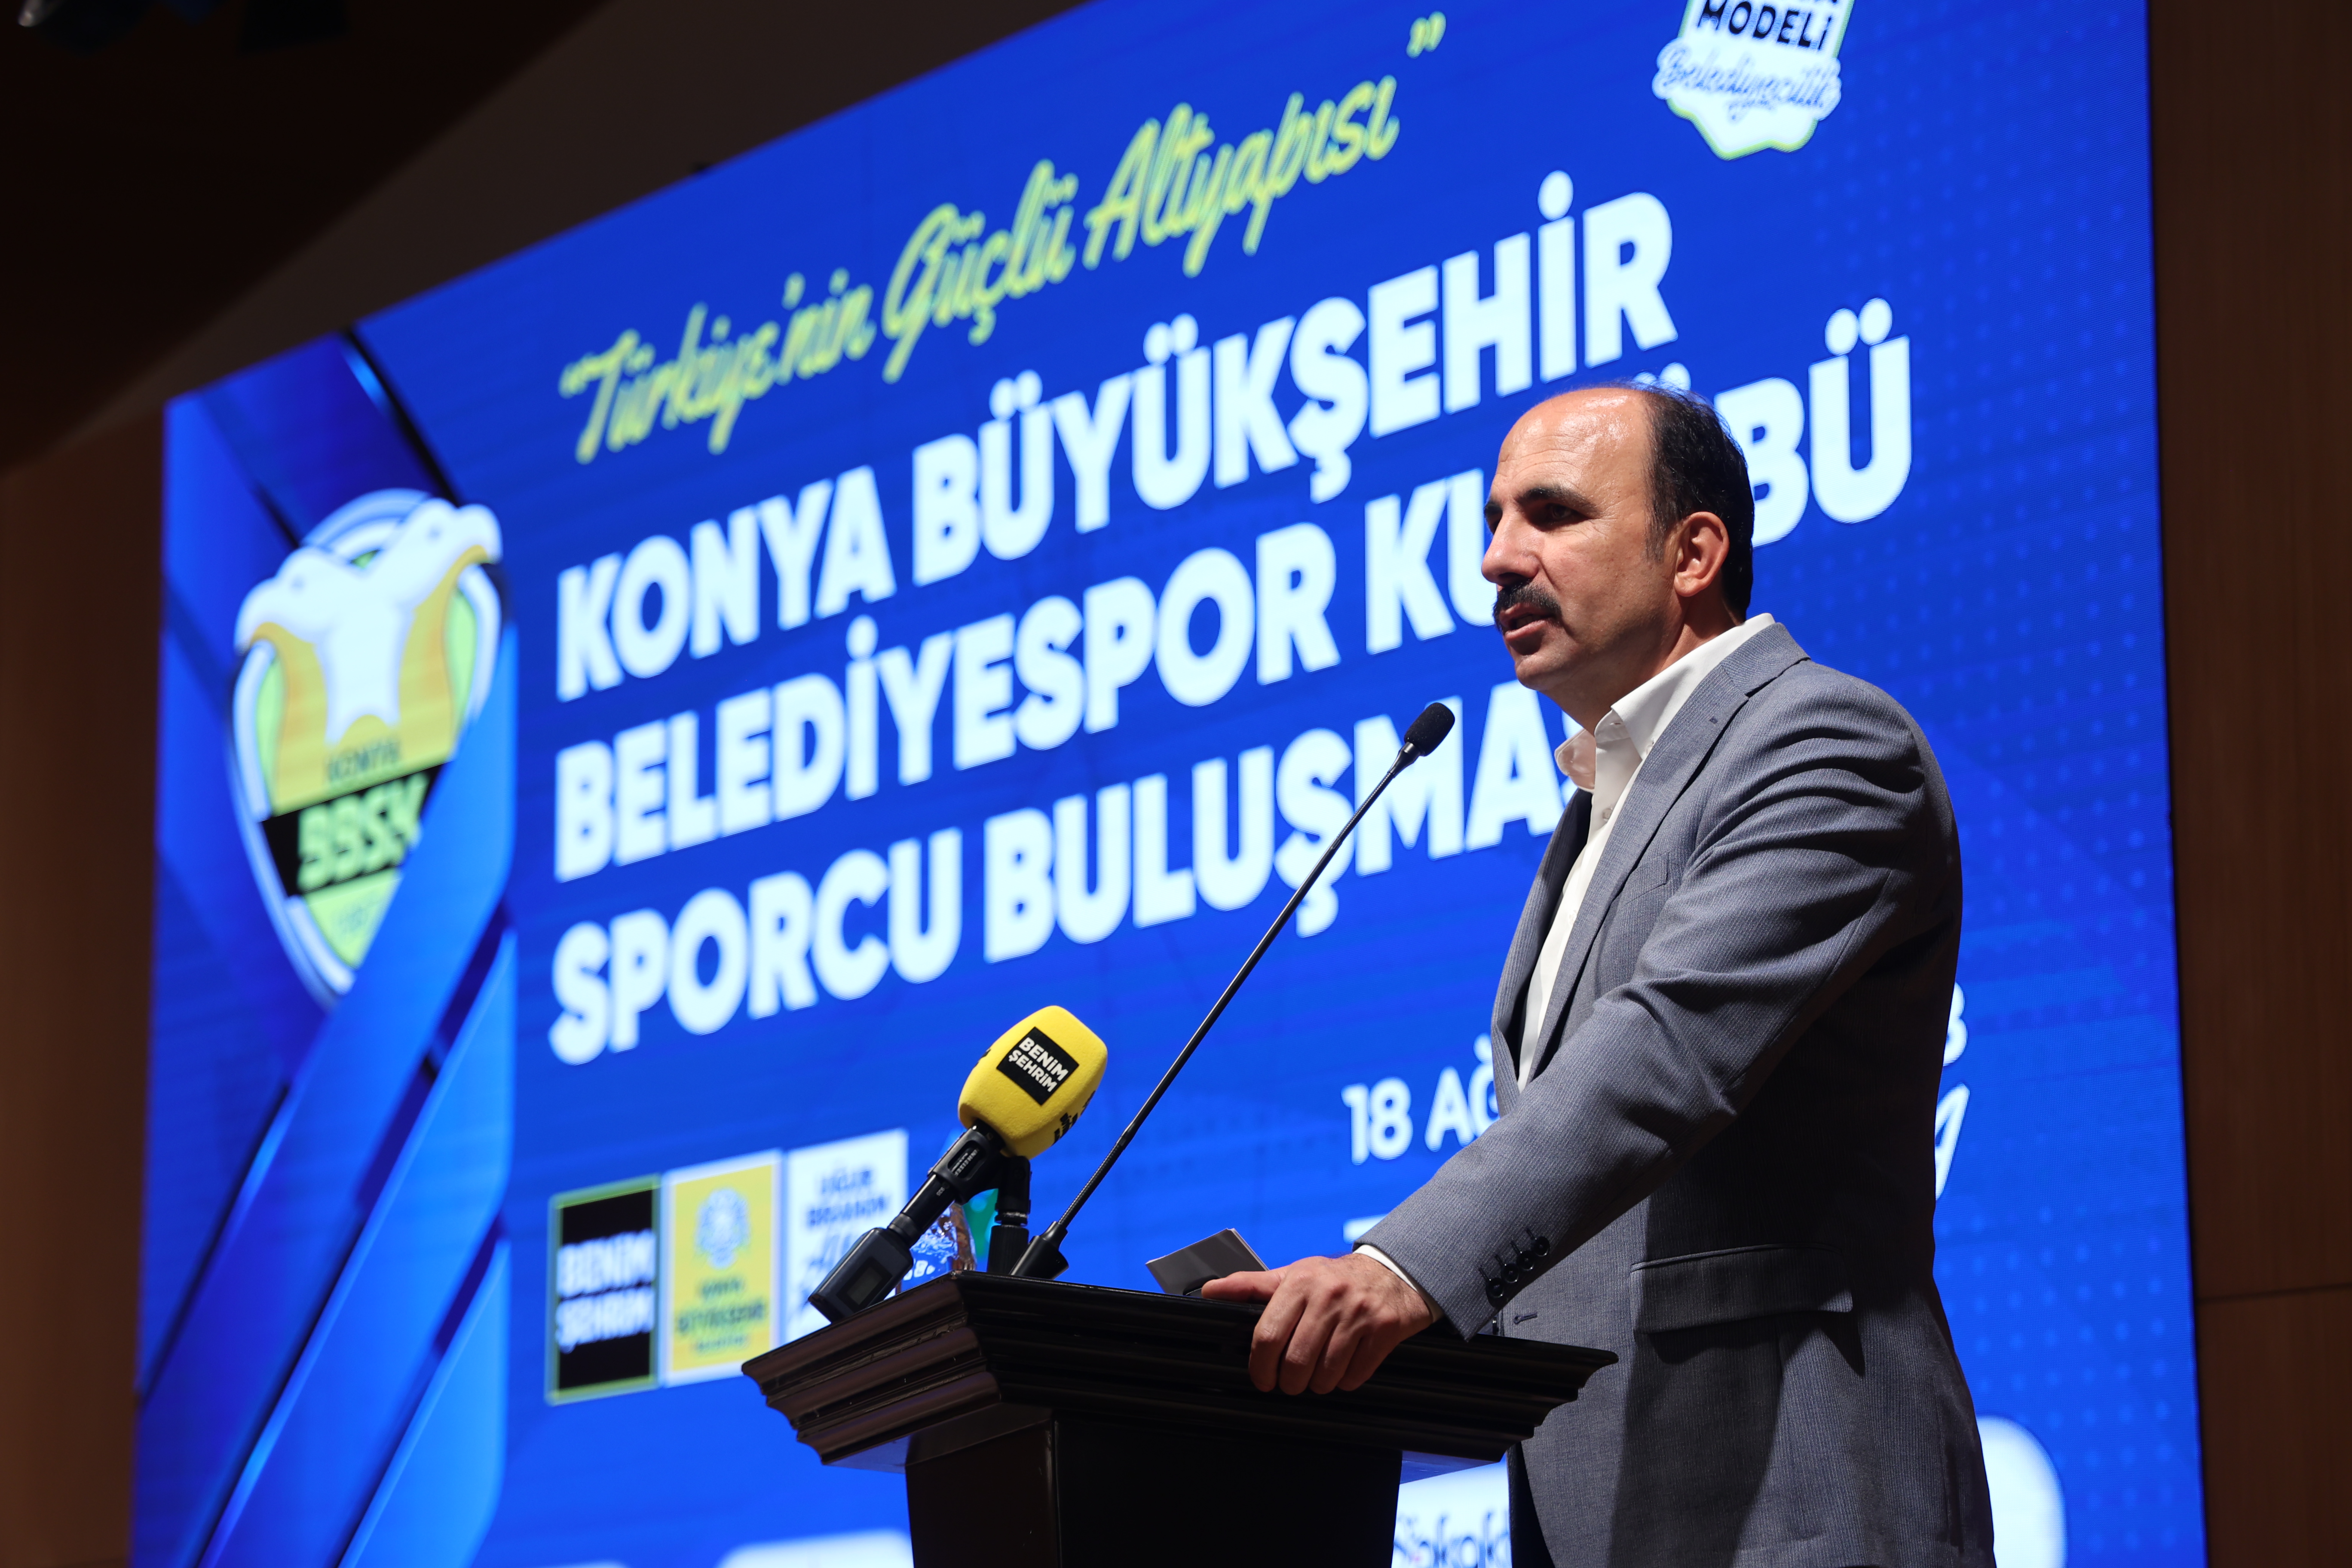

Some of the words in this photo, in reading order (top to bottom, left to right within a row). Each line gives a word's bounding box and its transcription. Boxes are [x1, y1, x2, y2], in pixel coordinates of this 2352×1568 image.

[881, 159, 1079, 383] Güçlü
[557, 466, 896, 702] KONYA
[912, 170, 1678, 587] BÜYÜKŞEHİR
[554, 522, 1341, 883] BELEDİYESPOR
[1364, 297, 1912, 654] KUBÜ
[548, 827, 962, 1066] SPORCU
[983, 680, 1571, 963] BULUŞMA
[1008, 1049, 1058, 1093] ŞEHRİM
[1018, 1037, 1069, 1081] BENİM
[1341, 1076, 1413, 1166] 18
